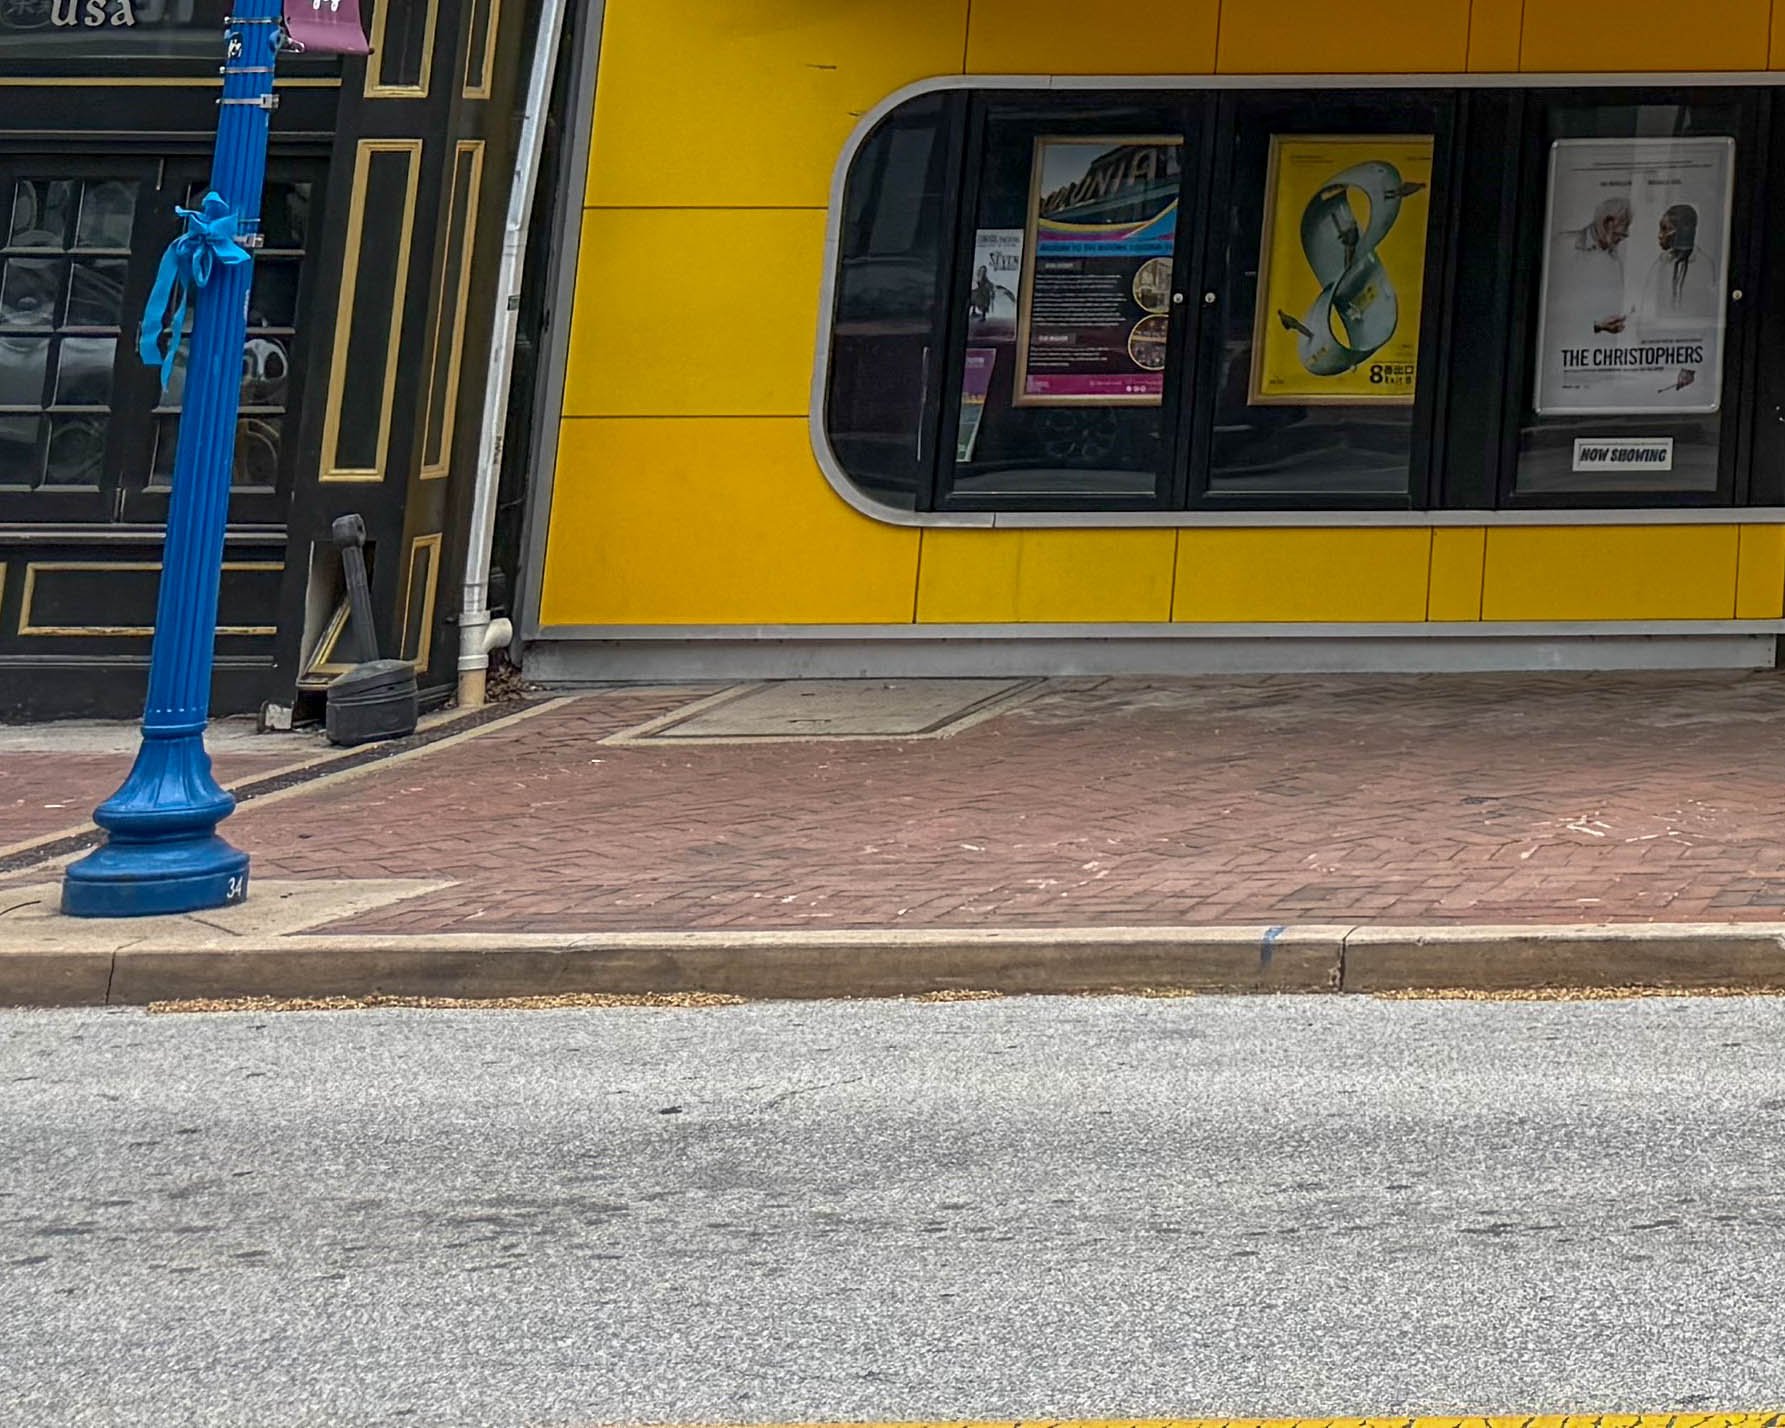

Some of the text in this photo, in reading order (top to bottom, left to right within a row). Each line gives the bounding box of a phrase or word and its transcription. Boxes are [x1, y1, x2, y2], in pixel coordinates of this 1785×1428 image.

[1561, 346, 1703, 367] THE CHRISTOPHERS
[1581, 448, 1609, 462] NOW
